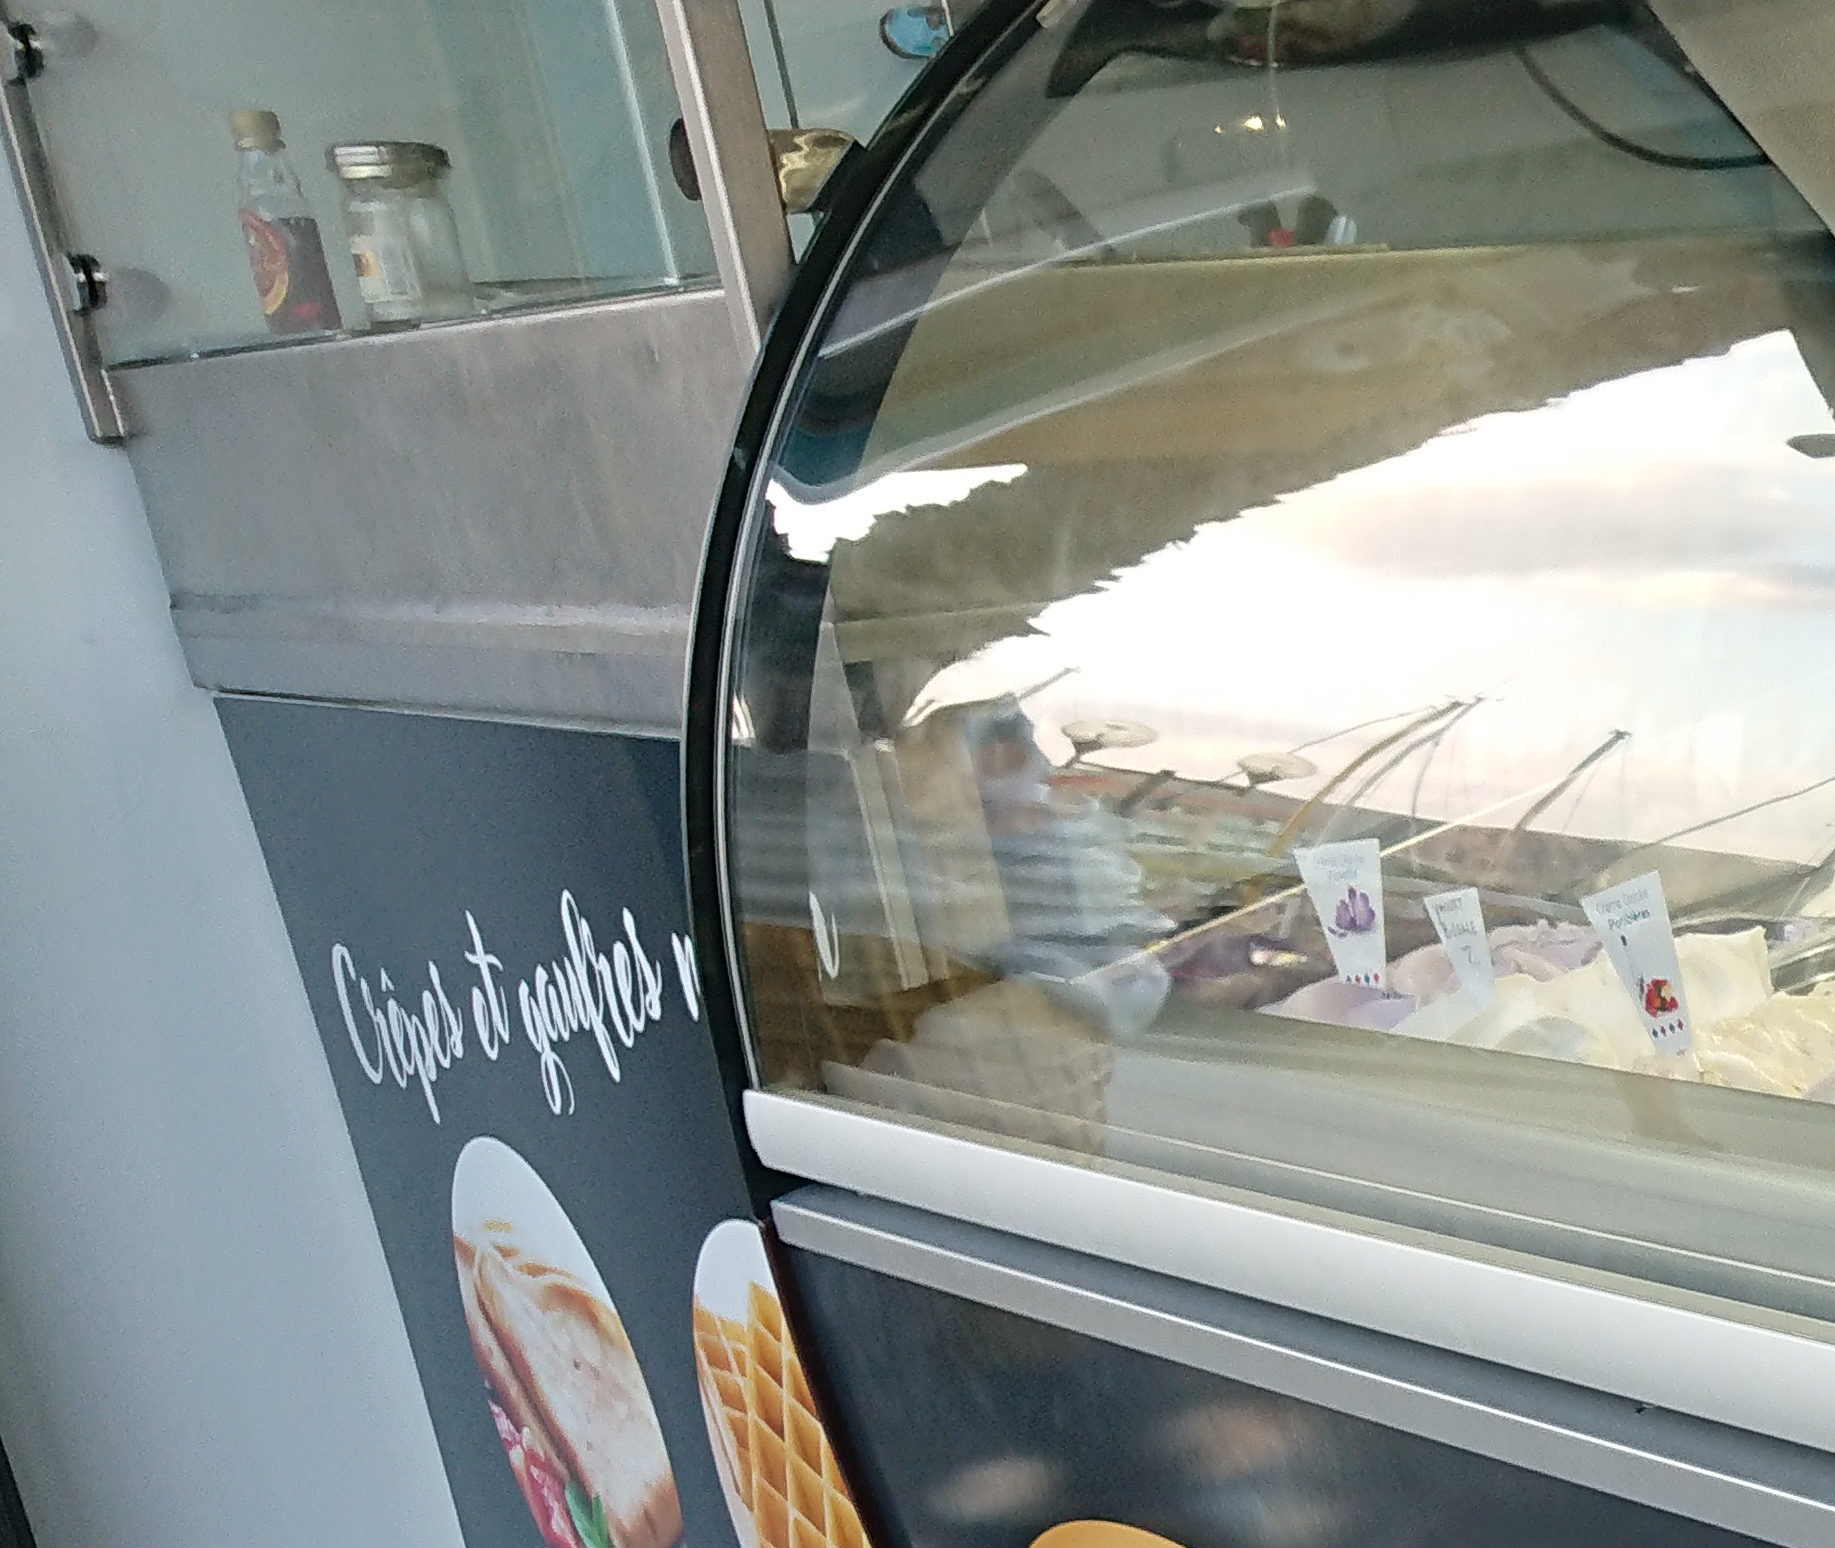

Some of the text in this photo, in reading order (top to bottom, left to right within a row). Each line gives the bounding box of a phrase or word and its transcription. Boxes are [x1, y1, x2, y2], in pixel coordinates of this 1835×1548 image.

[331, 943, 464, 1125] Crêpes
[464, 909, 511, 1061] et
[518, 888, 664, 1116] gaufres
